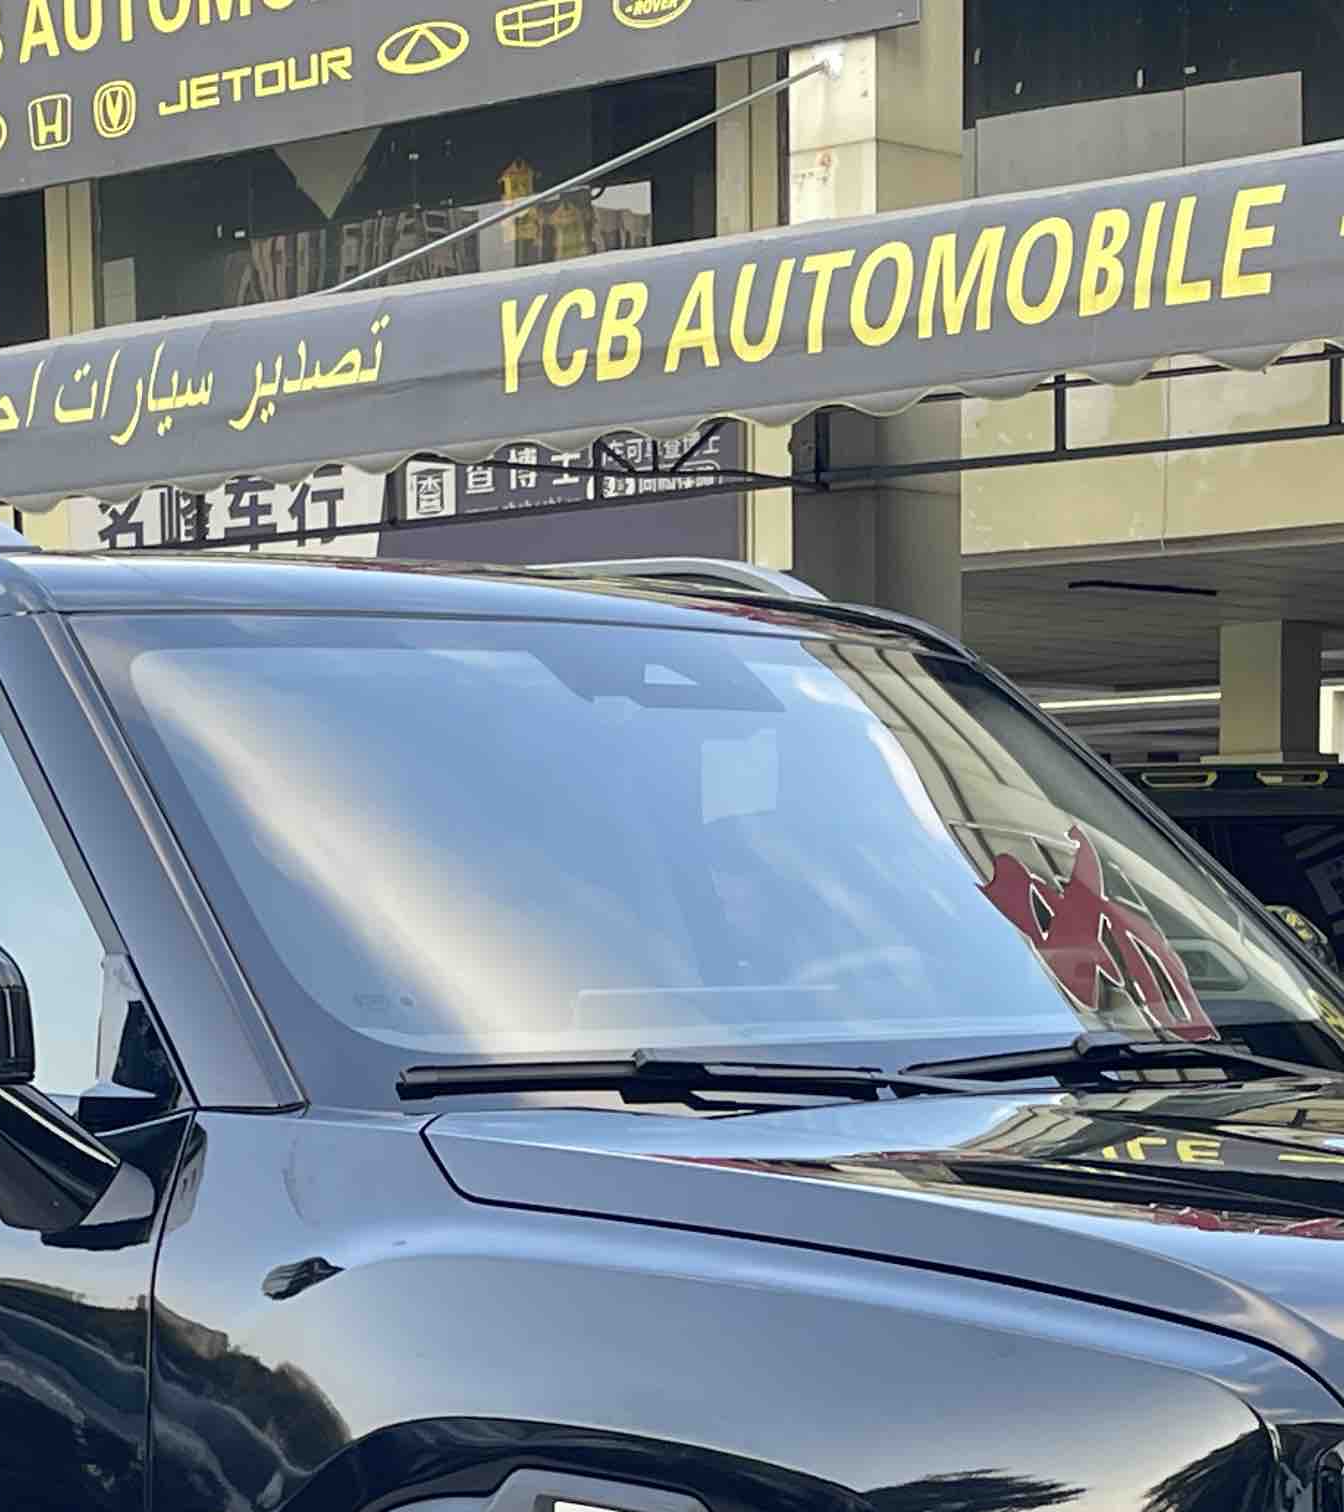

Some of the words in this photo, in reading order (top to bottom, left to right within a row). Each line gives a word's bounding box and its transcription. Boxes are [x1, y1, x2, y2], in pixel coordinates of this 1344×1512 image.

[158, 46, 353, 116] JETOUR
[500, 281, 647, 393] YCB
[665, 184, 1286, 372] AUTOMOBILE
[54, 337, 214, 447] سيارات
[229, 313, 392, 431] تصدير
